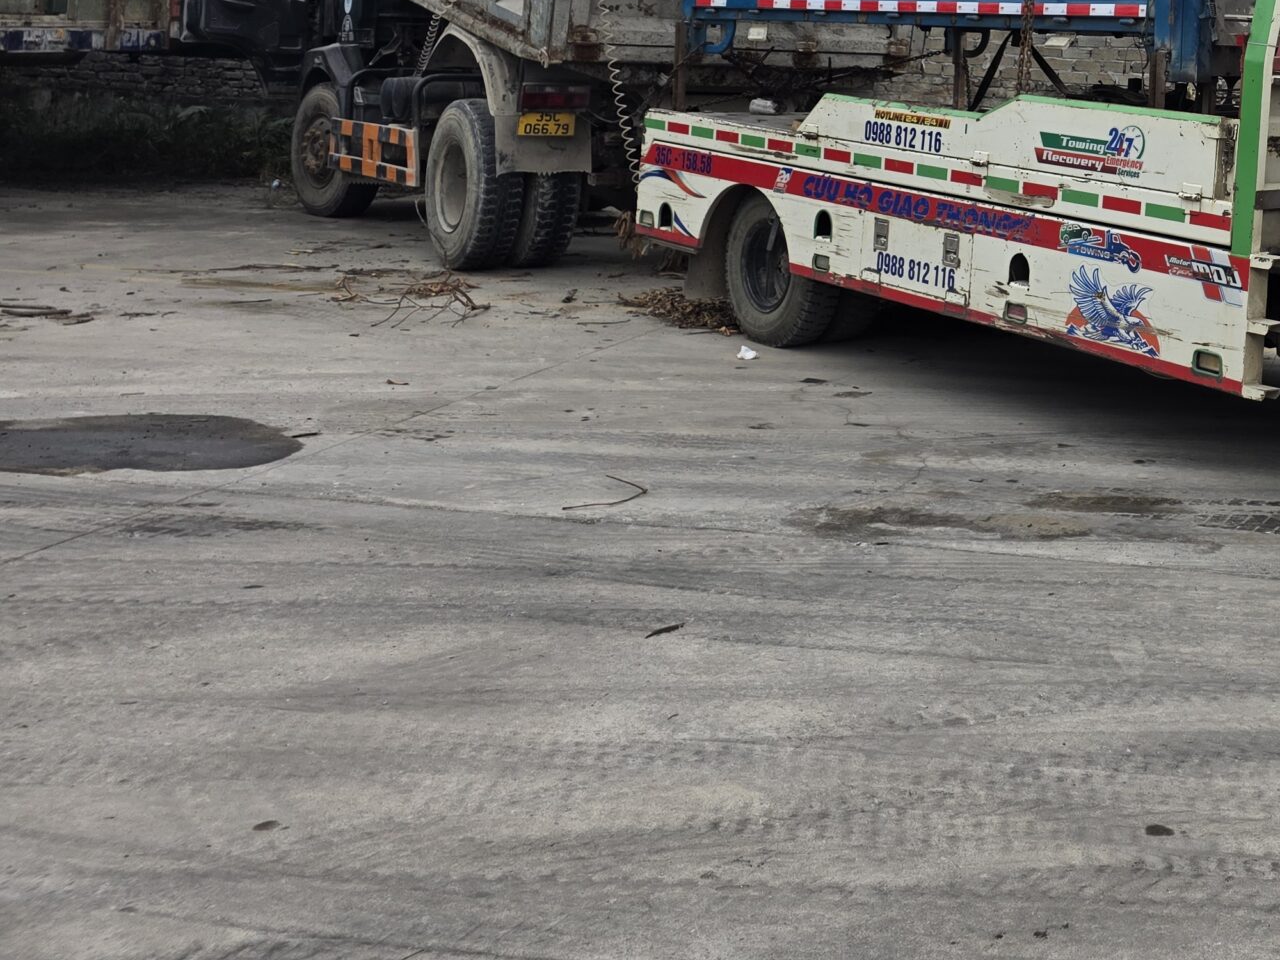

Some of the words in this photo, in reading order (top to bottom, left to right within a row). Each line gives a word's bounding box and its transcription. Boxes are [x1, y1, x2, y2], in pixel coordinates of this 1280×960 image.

[875, 109, 904, 122] HOTLINE
[524, 123, 569, 135] 066.79
[865, 120, 892, 144] 0988
[895, 125, 917, 148] 812
[920, 129, 942, 153] 116
[1060, 136, 1105, 154] Towing
[655, 146, 672, 165] 35C
[681, 150, 712, 174] 158.58
[1041, 150, 1104, 171] Recovery
[1106, 156, 1144, 170] Emergency
[1117, 168, 1140, 178] Services
[878, 191, 929, 220] GIAO
[1073, 245, 1110, 259] TOWING
[1169, 256, 1191, 266] Motor
[877, 251, 904, 278] 0988
[908, 259, 930, 284] 812
[934, 265, 955, 290] 116
